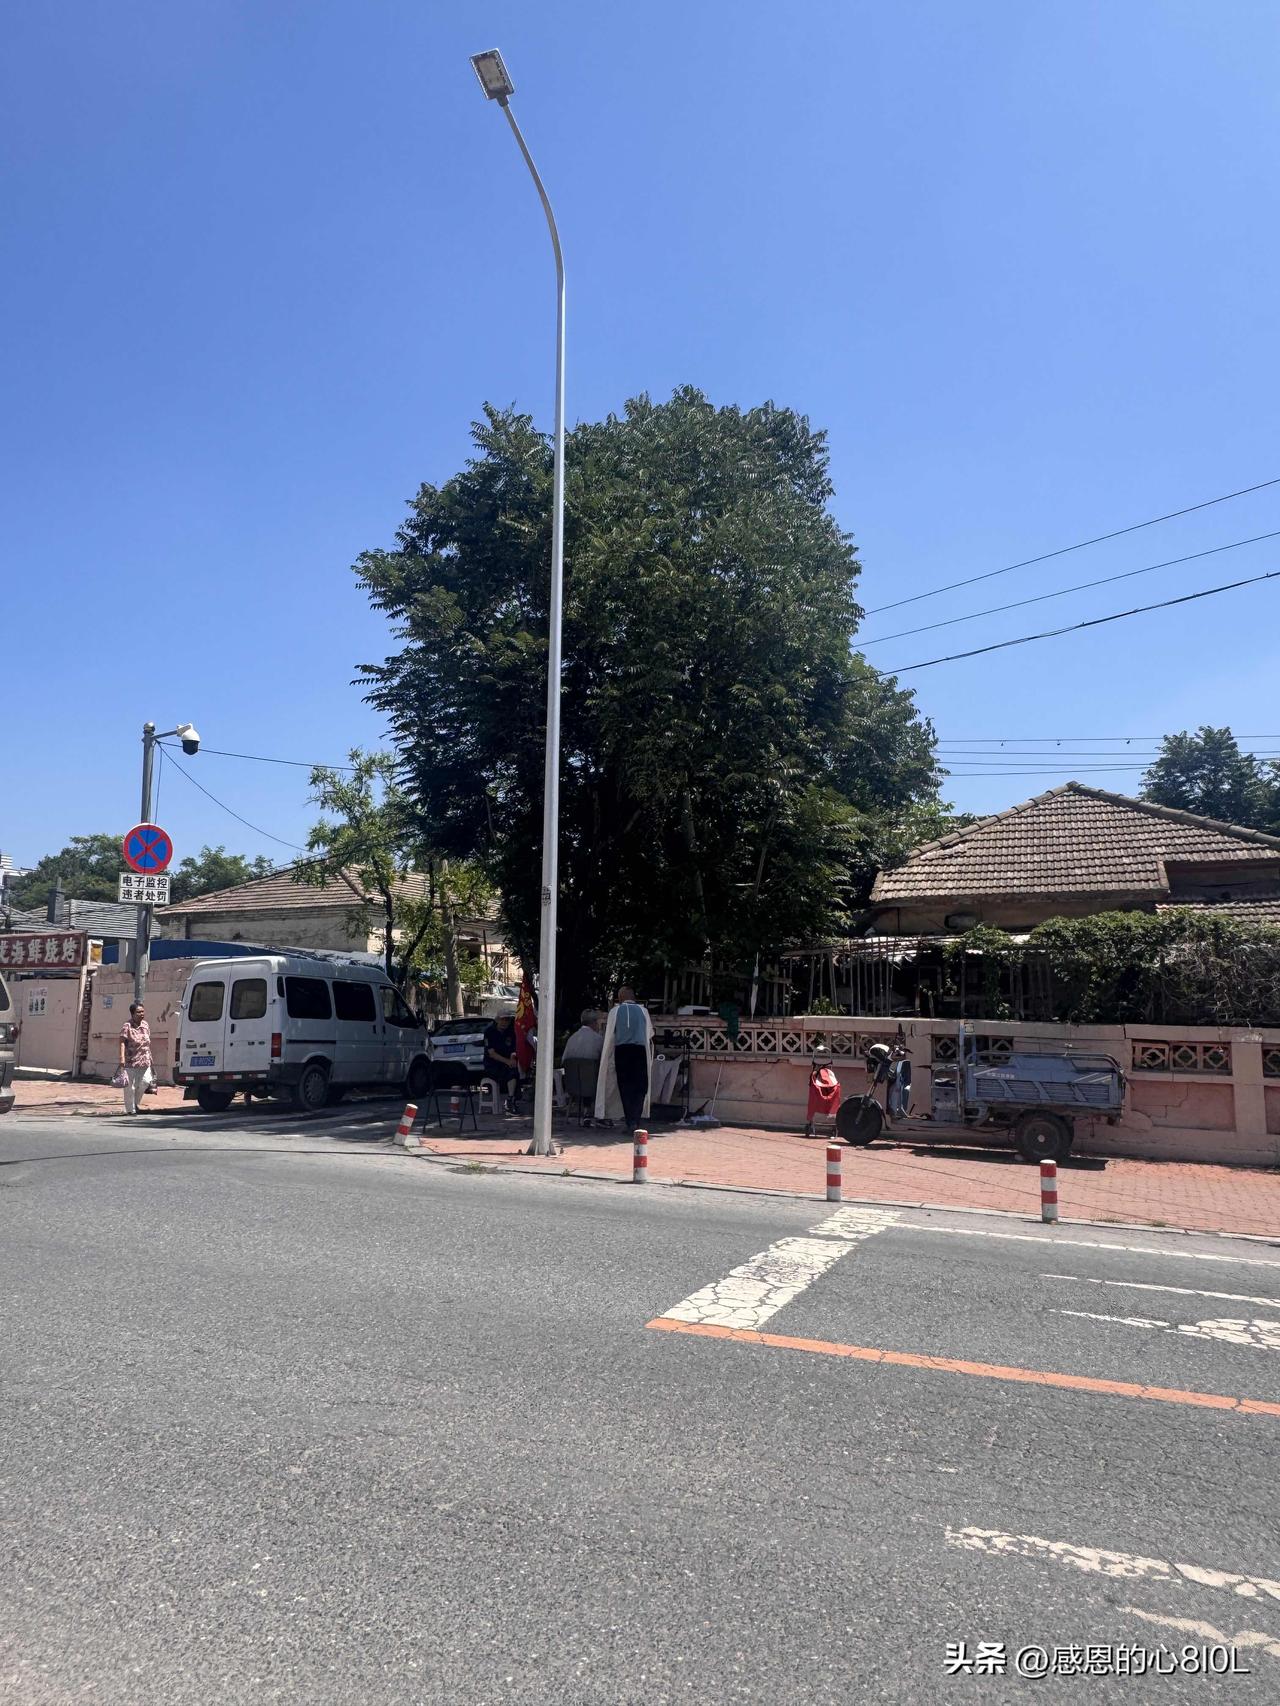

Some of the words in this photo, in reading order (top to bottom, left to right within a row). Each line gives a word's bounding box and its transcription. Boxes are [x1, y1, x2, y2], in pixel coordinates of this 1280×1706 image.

[122, 875, 168, 888] 电子监控
[122, 889, 167, 901] 违者处罚
